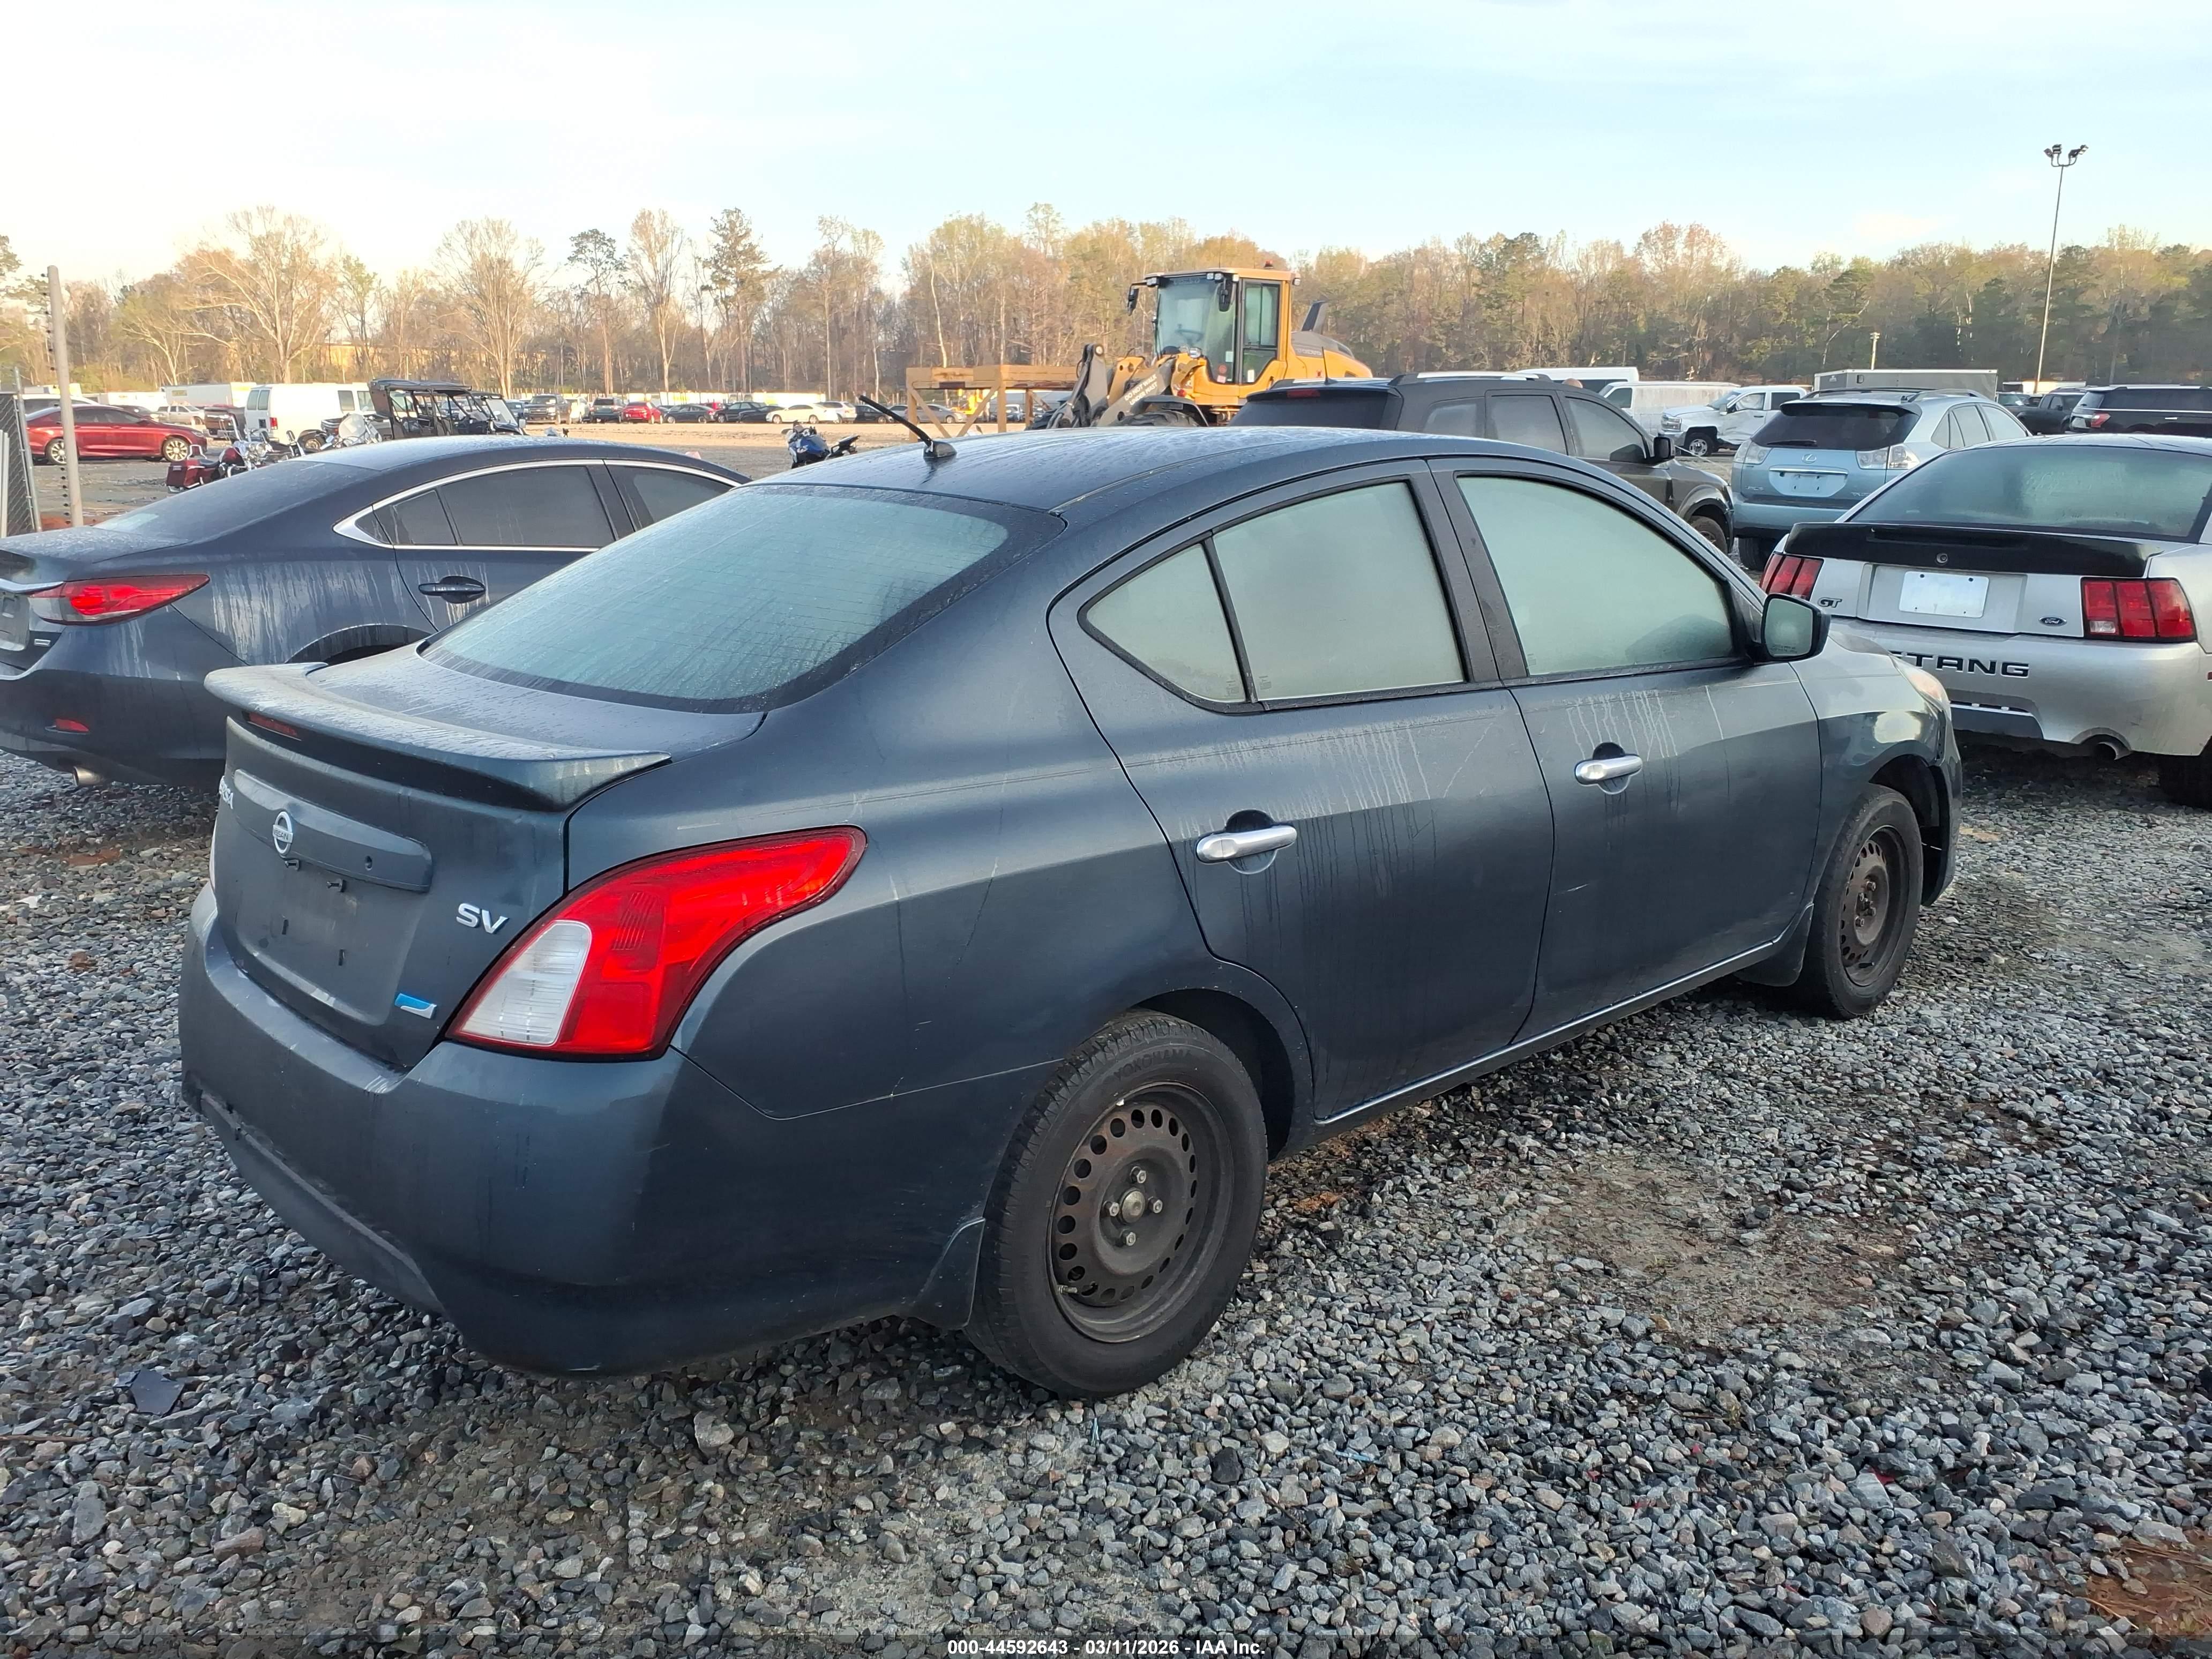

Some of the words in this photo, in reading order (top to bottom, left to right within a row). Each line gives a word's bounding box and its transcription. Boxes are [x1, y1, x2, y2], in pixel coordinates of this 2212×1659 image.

[1124, 392, 1133, 401] DO
[1132, 384, 1143, 395] NOT
[1142, 373, 1157, 386] WALK
[1129, 391, 1146, 405] UNDER
[1145, 381, 1157, 394] MAST
[1817, 597, 1842, 608] GT
[456, 903, 509, 933] SV
[1113, 1048, 1192, 1081] YOKOHAMA
